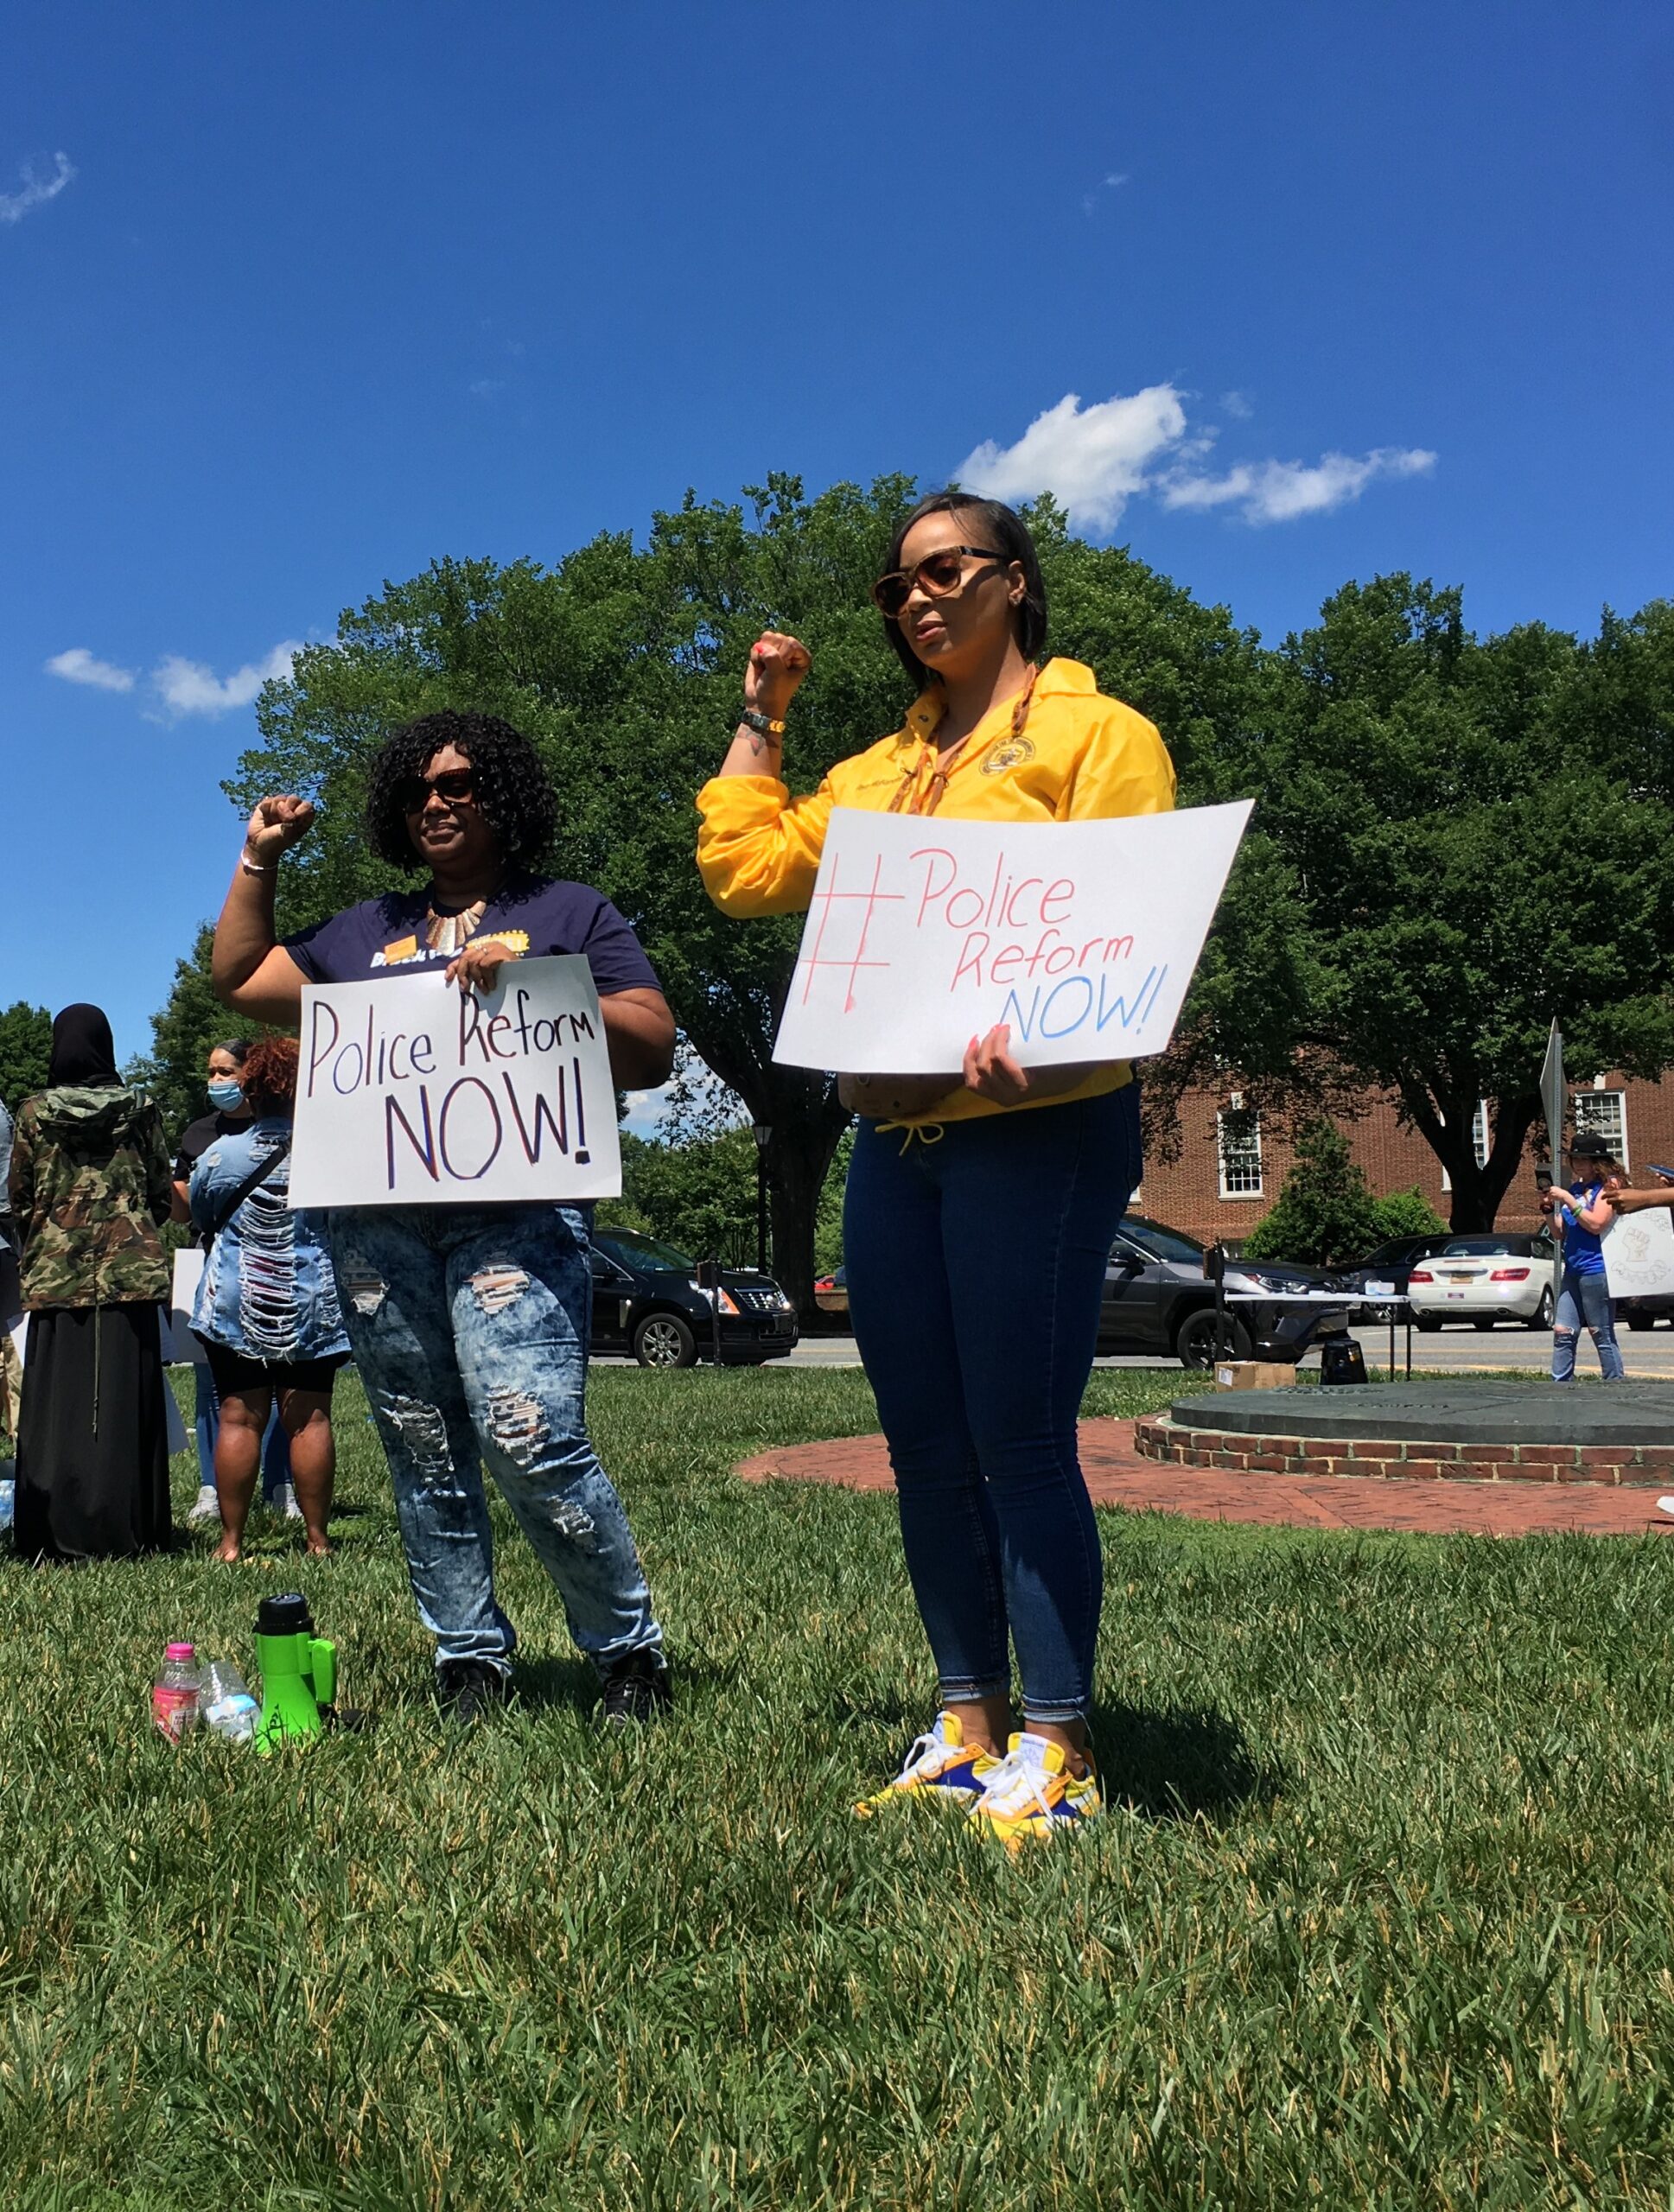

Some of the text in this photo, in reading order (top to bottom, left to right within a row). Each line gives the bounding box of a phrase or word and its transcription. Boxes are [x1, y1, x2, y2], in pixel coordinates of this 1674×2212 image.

[951, 928, 1134, 992] Reform
[999, 964, 1168, 1043] NOW!
[308, 1000, 436, 1098] Police
[385, 1056, 591, 1190] NOW!
